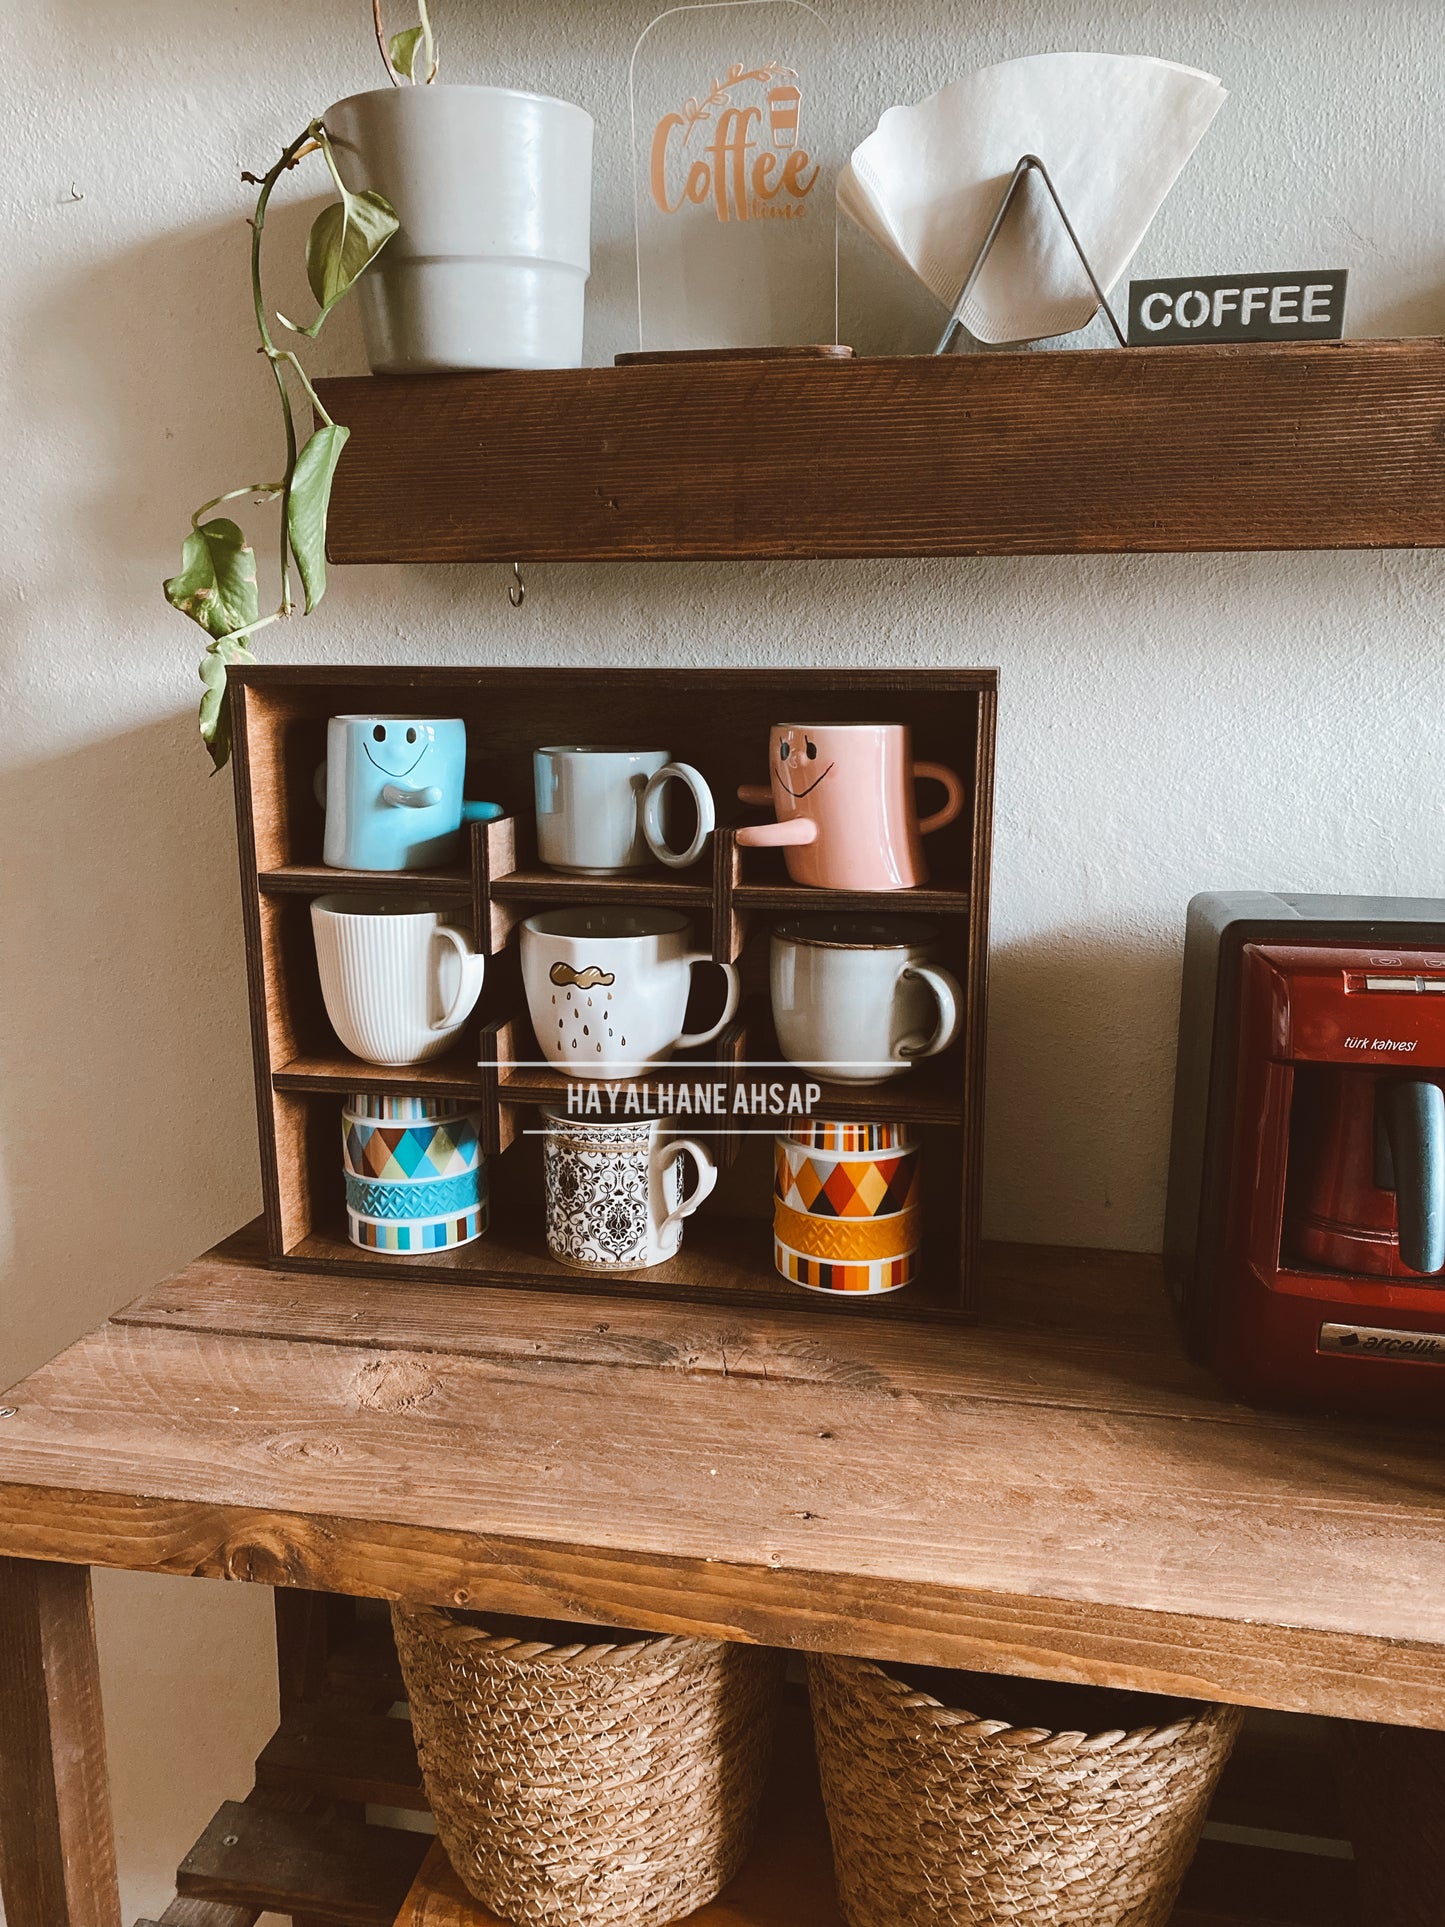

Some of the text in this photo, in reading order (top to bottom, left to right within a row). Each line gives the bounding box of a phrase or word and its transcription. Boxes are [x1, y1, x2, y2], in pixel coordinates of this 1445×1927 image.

[651, 106, 820, 222] Coffee
[1141, 285, 1333, 332] COFFEE
[1344, 1036, 1418, 1052] türk kahvesi
